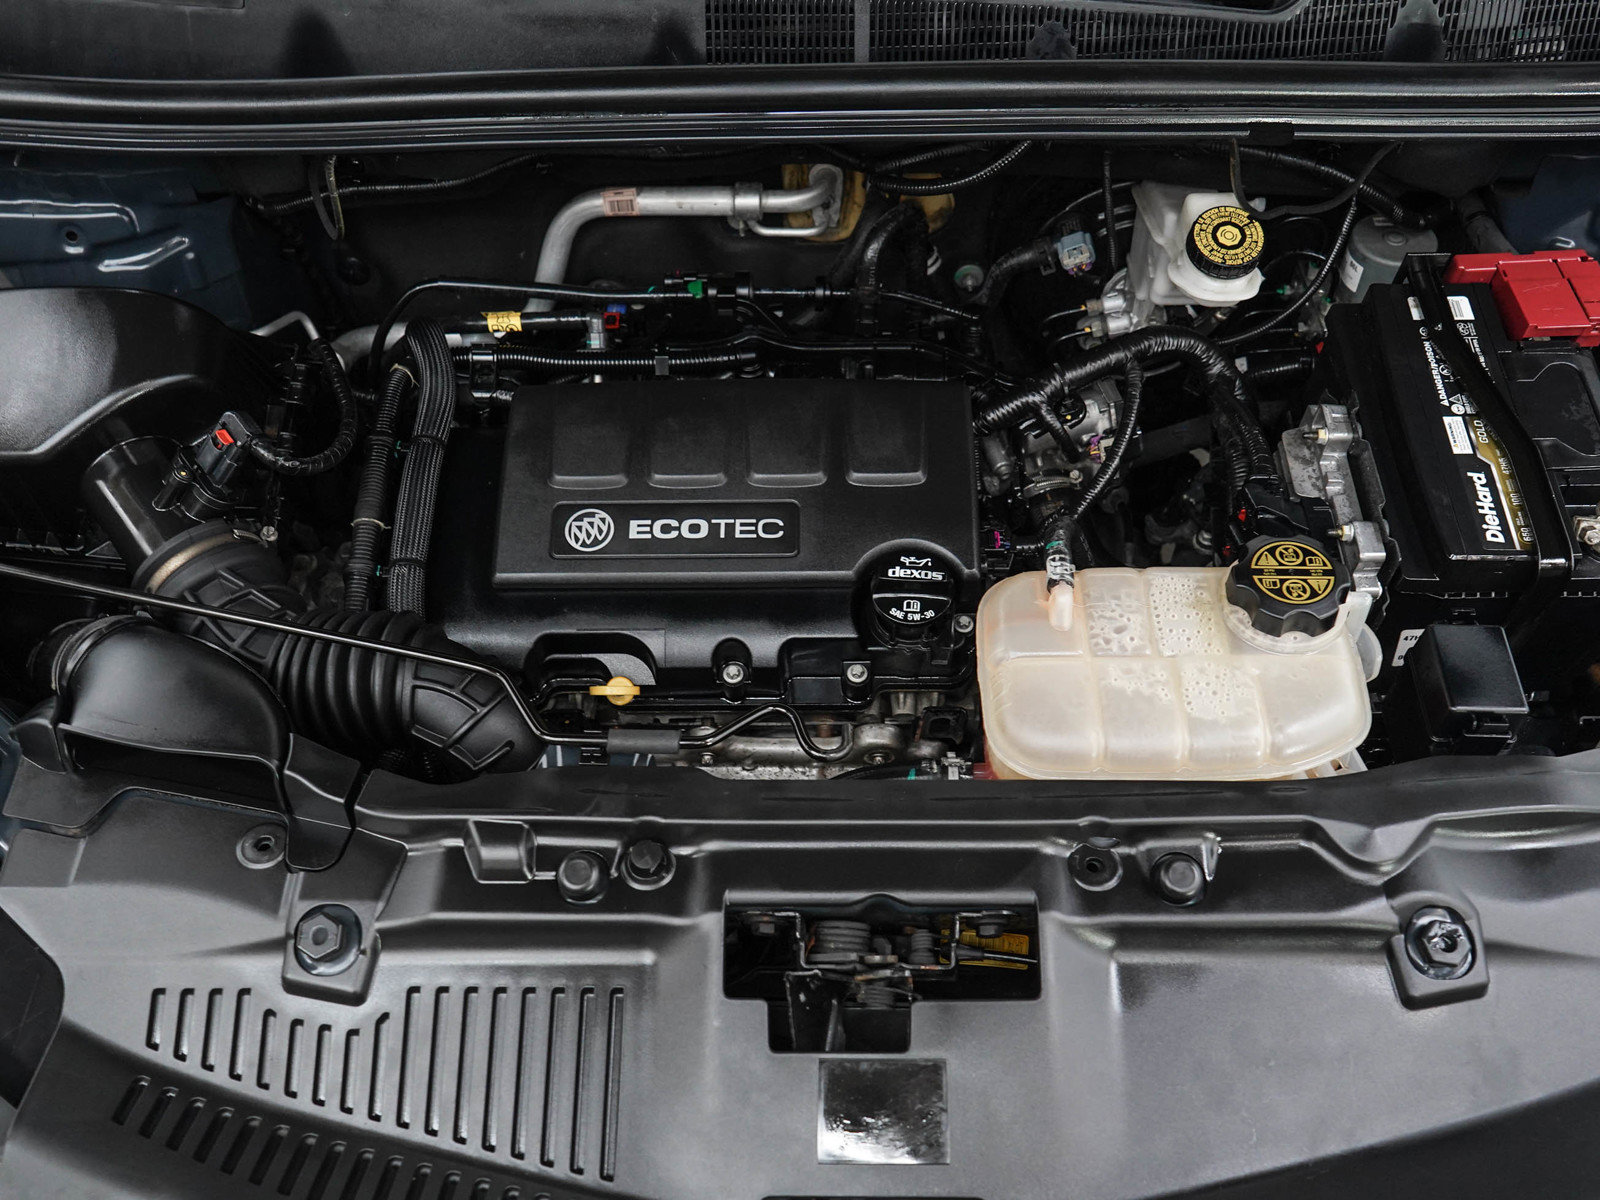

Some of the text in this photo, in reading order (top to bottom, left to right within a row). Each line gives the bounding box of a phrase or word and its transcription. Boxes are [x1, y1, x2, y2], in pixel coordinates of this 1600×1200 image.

[1423, 341, 1447, 400] DANGER/POISON
[1473, 420, 1489, 444] GOLD
[1467, 472, 1505, 544] DieHard
[628, 518, 785, 539] ECOTEC
[888, 566, 945, 581] dexos
[889, 608, 935, 621] SAE 5W-30
